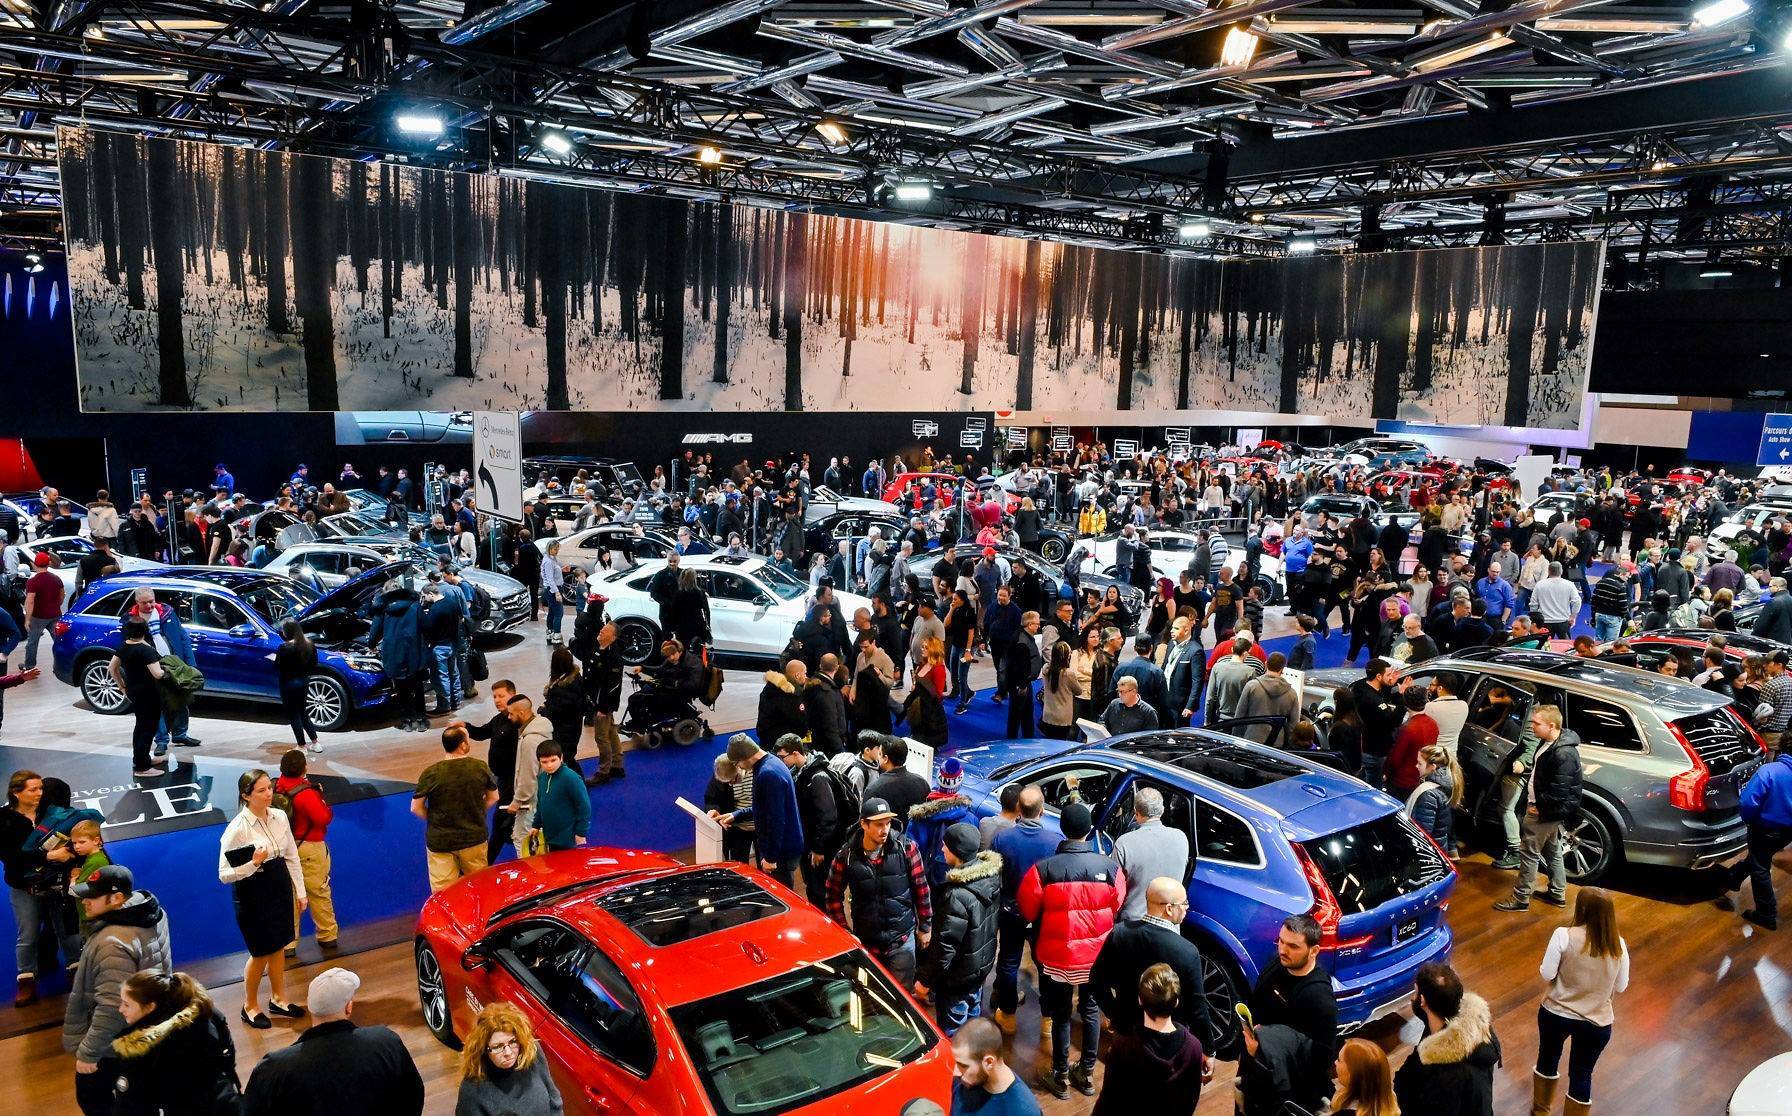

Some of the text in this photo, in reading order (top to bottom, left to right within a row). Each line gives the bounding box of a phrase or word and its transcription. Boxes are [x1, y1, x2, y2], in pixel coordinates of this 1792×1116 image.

[1765, 427, 1787, 435] Parcours
[496, 447, 512, 460] smart
[71, 782, 144, 799] uveau
[73, 782, 213, 829] LE
[1398, 921, 1418, 936] XC60
